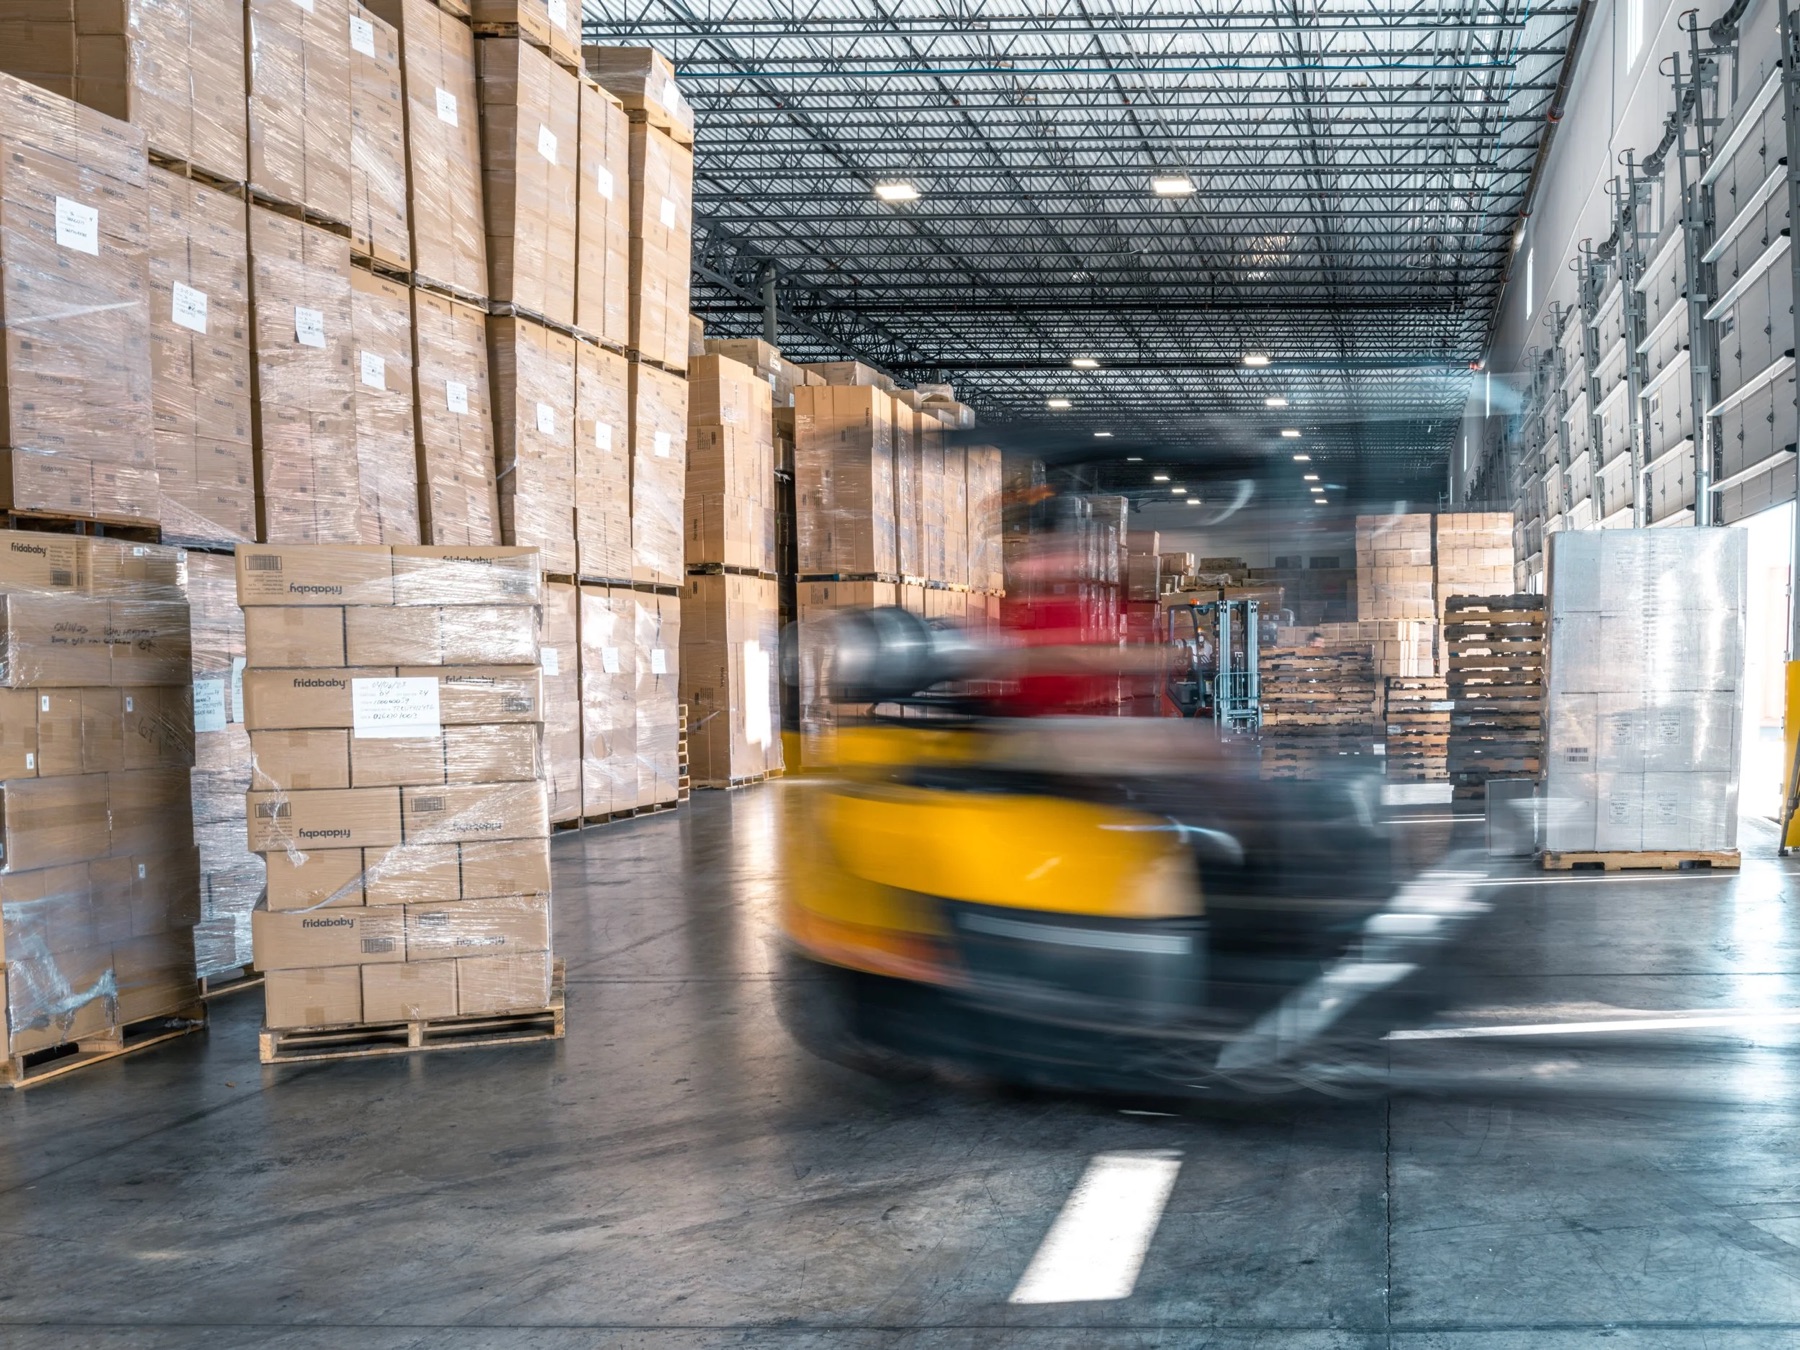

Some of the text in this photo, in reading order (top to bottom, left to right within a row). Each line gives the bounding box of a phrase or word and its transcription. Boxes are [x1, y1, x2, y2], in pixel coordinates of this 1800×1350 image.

[11, 542, 48, 558] fridababy
[289, 582, 343, 595] fridababy
[293, 678, 348, 689] fridababy
[299, 828, 351, 839] fridababy
[302, 917, 355, 929] fridababy
[456, 936, 505, 946] friaby
